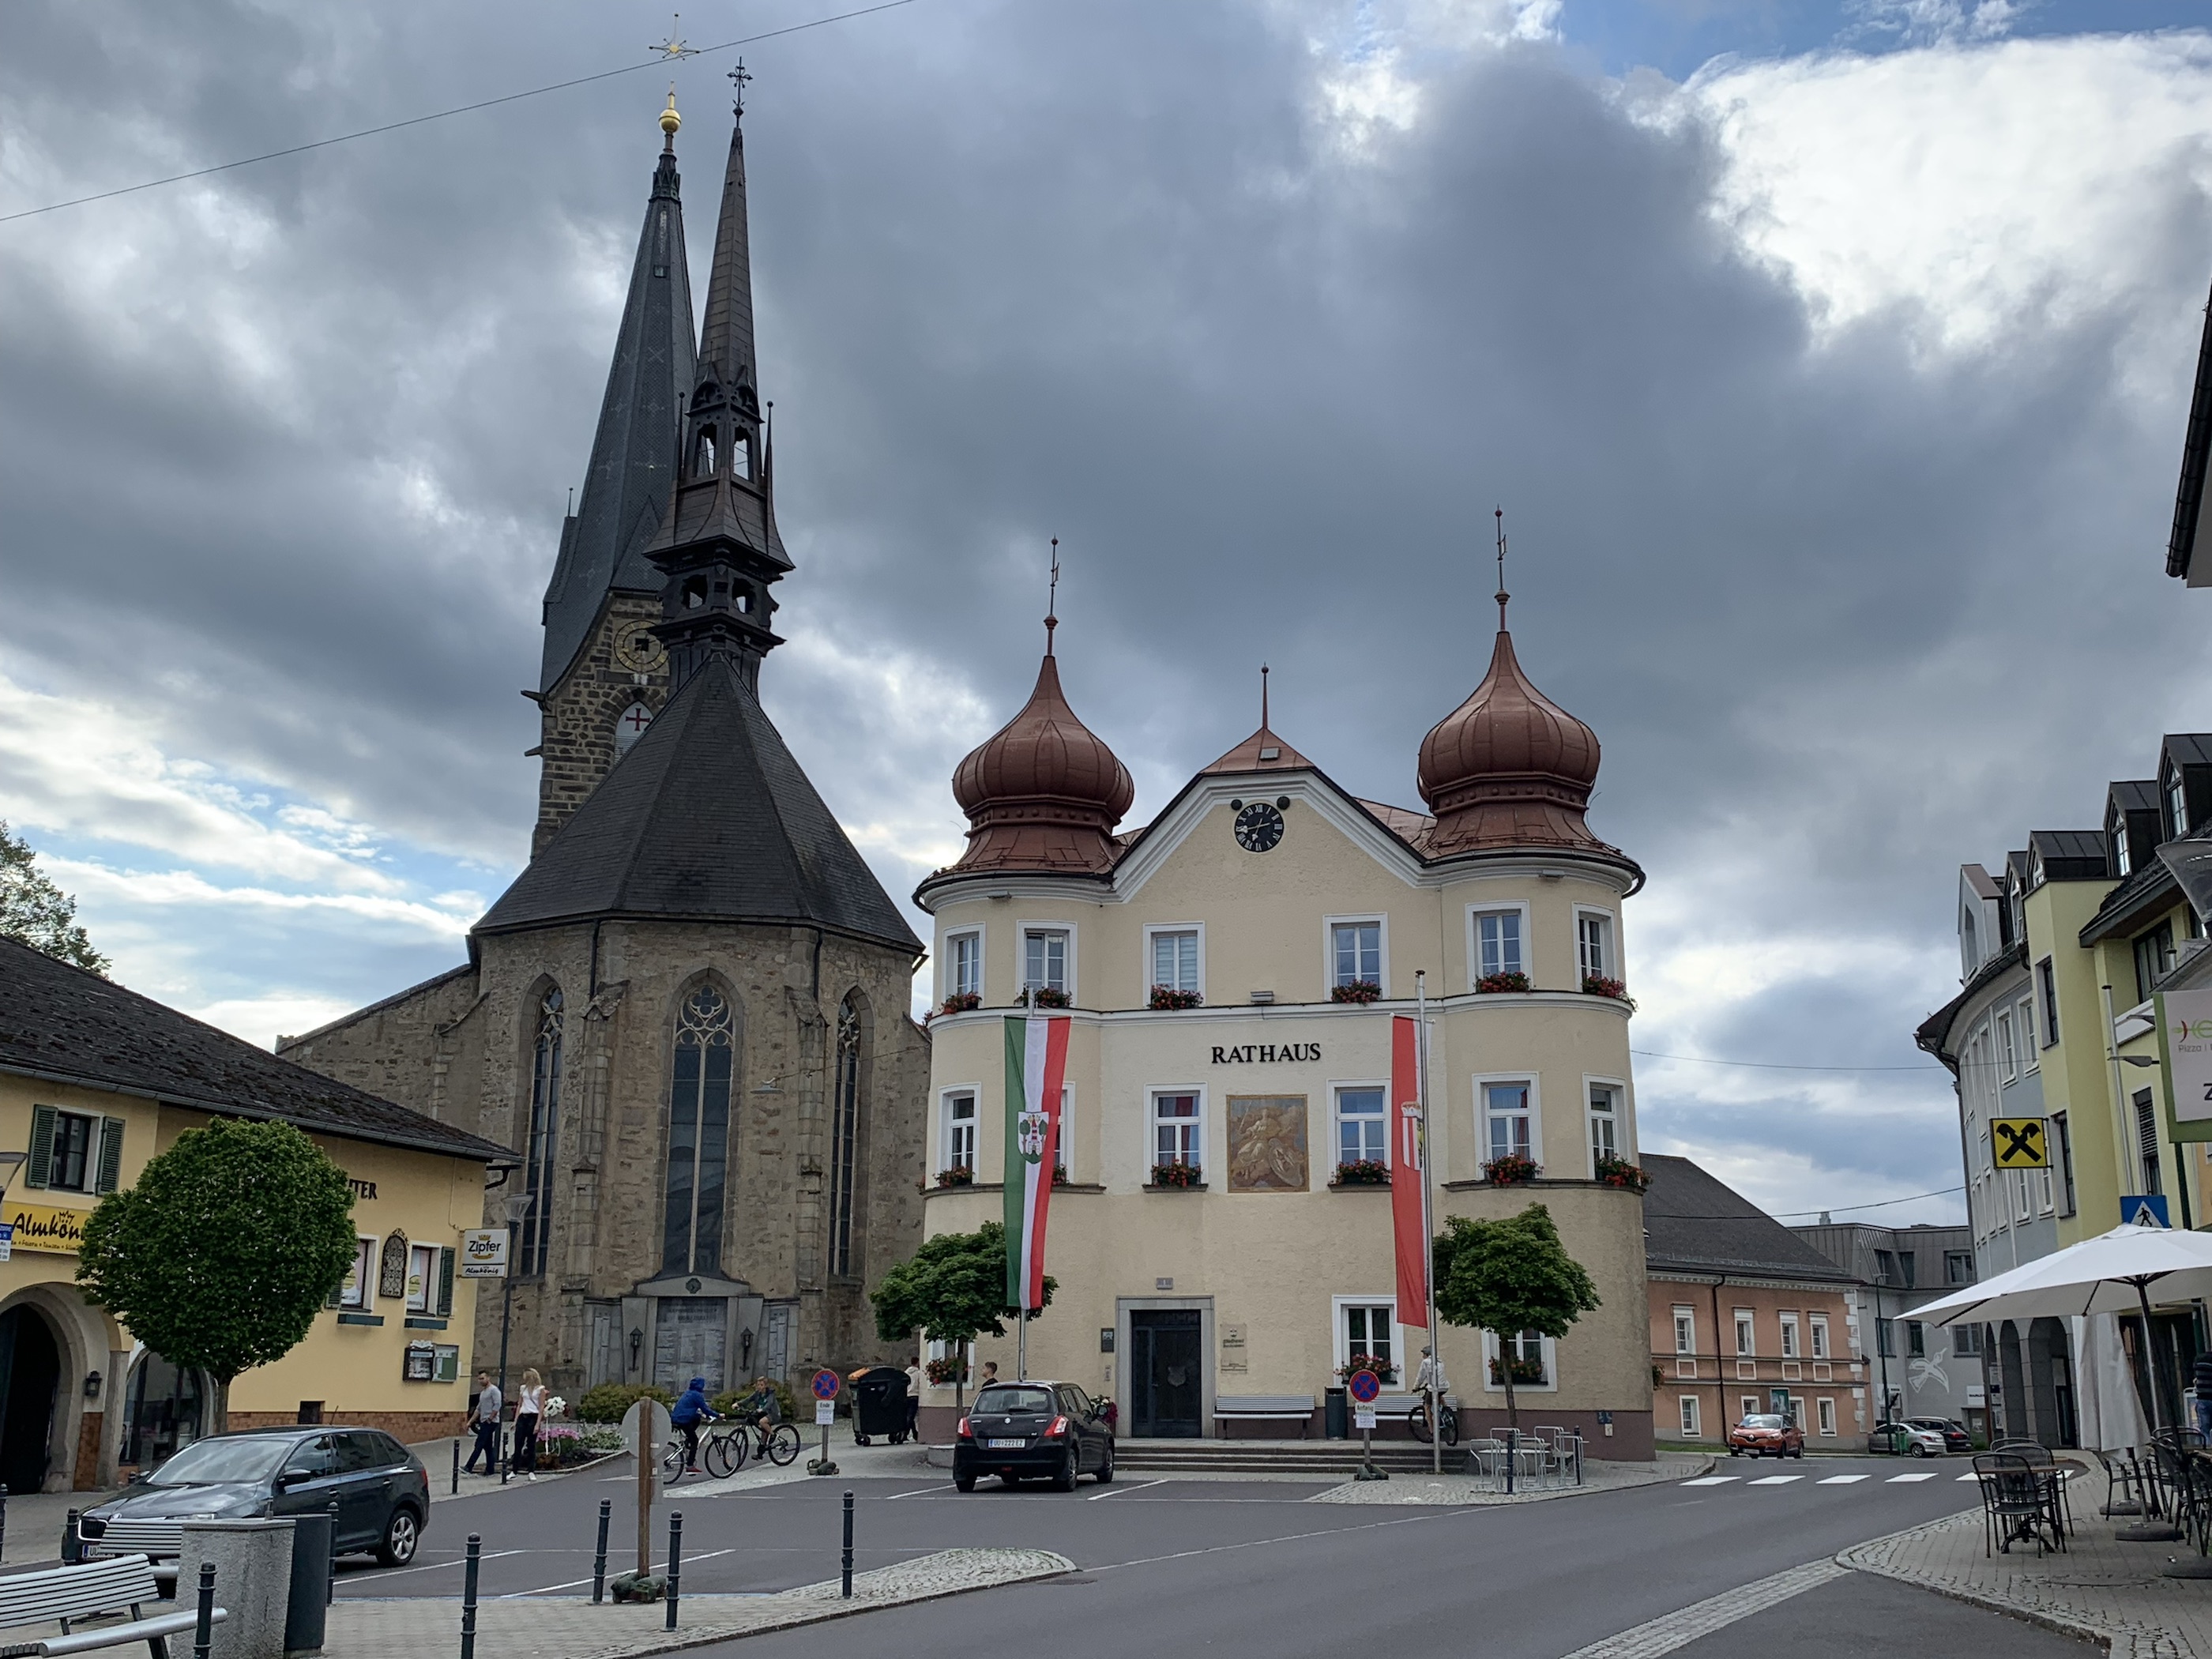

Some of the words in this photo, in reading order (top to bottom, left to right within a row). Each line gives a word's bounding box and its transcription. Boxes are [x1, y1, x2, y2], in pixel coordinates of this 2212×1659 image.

[1211, 1043, 1322, 1064] RATHAUS
[2178, 1044, 2202, 1053] Pizza
[468, 1240, 502, 1255] Zipfer
